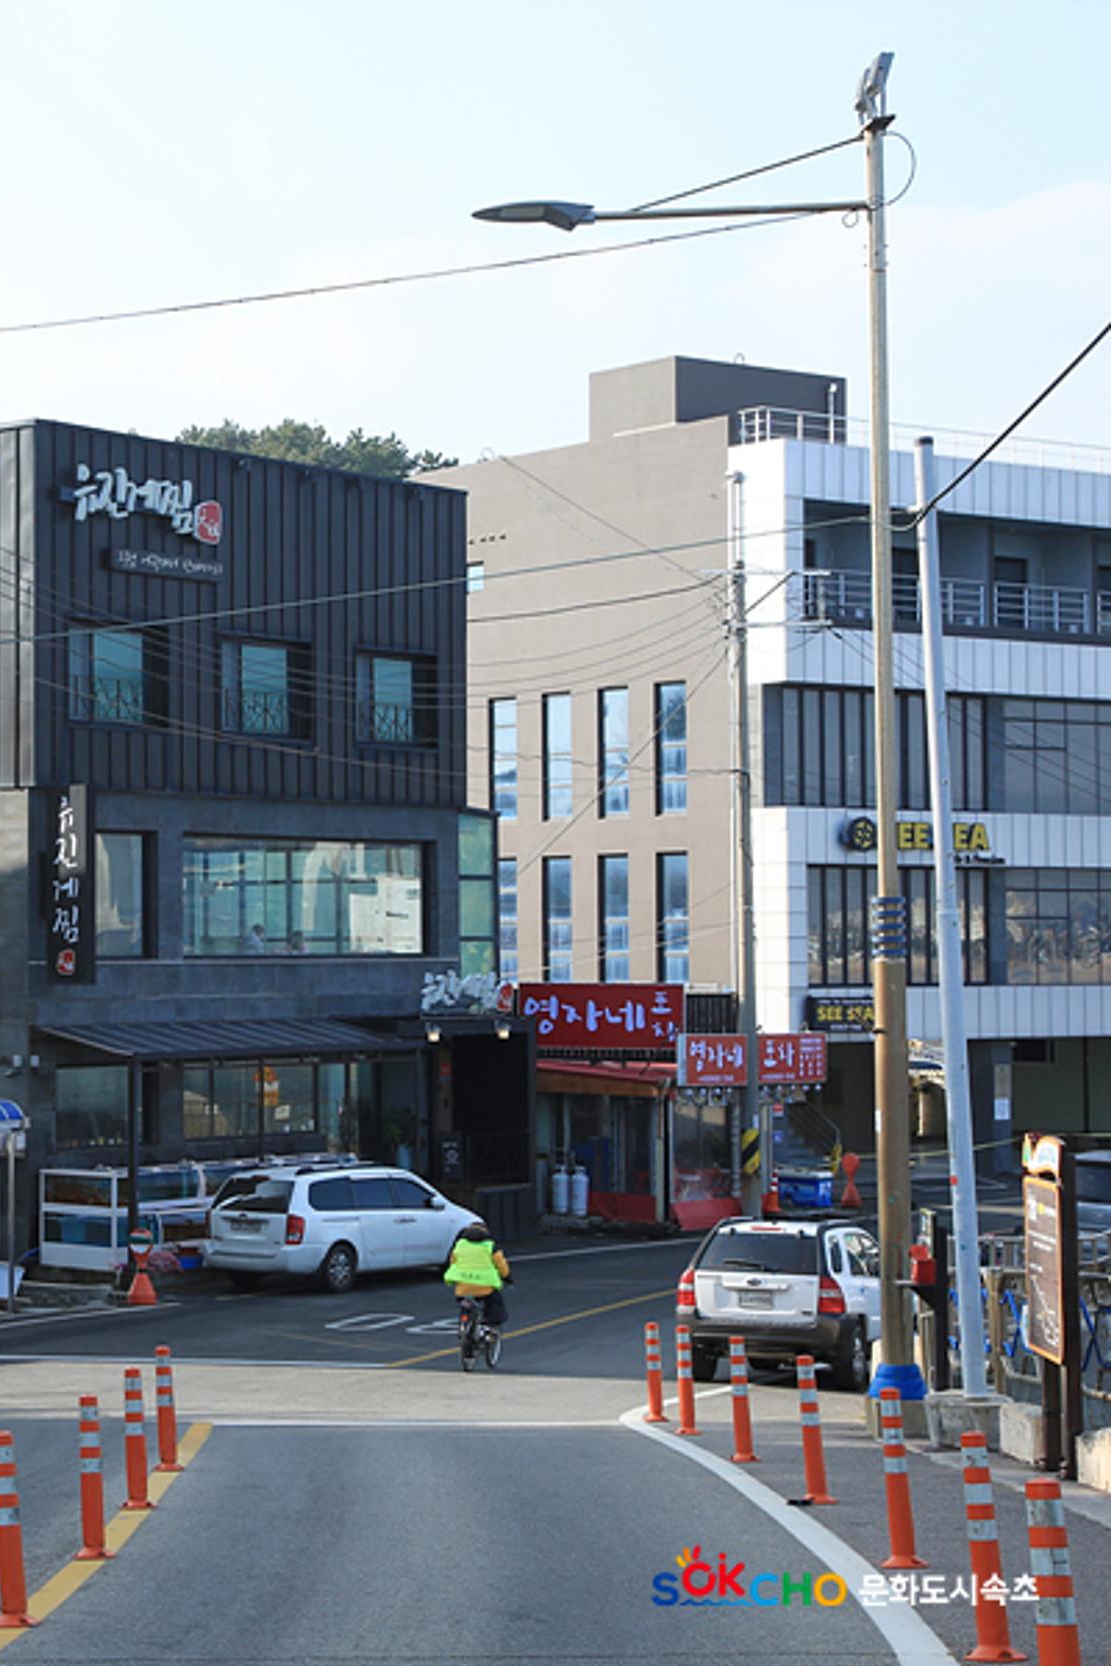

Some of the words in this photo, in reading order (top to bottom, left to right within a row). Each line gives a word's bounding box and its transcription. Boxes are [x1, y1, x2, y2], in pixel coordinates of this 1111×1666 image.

[895, 821, 935, 850] EE
[952, 821, 990, 851] EA
[523, 994, 647, 1035] 영자네
